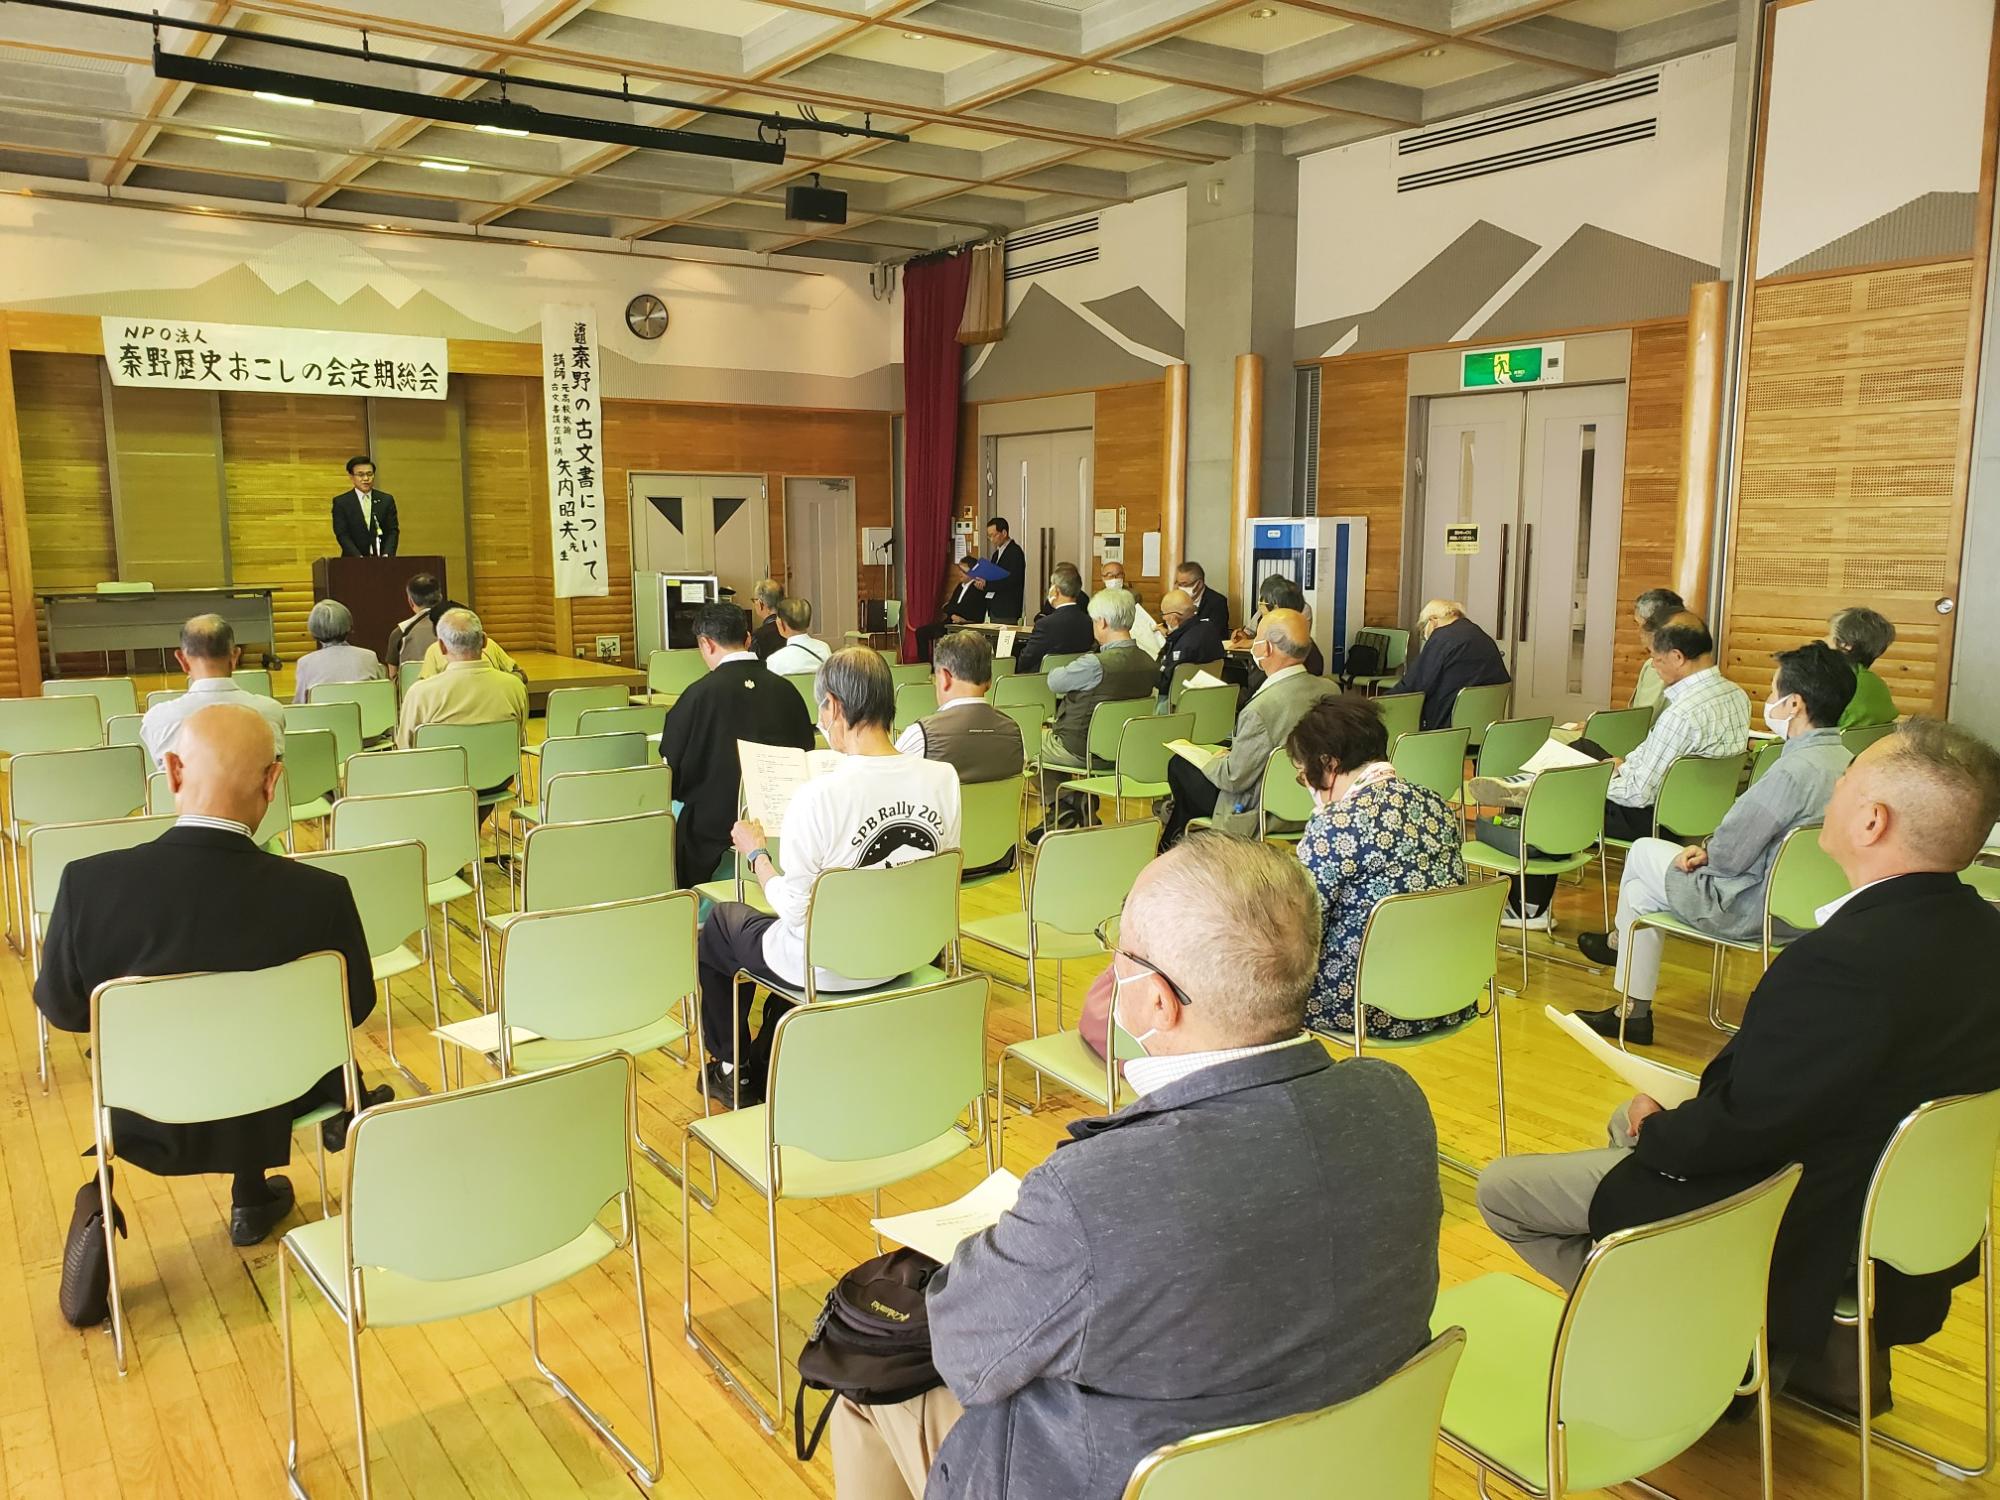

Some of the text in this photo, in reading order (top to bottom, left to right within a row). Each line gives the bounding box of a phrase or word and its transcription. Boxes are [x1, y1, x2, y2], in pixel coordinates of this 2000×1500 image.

[124, 326, 208, 345] NPO法人
[117, 343, 439, 393] 秦野歴史おこしの会定期総会
[851, 816, 878, 848] SPB
[878, 801, 915, 822] Rally
